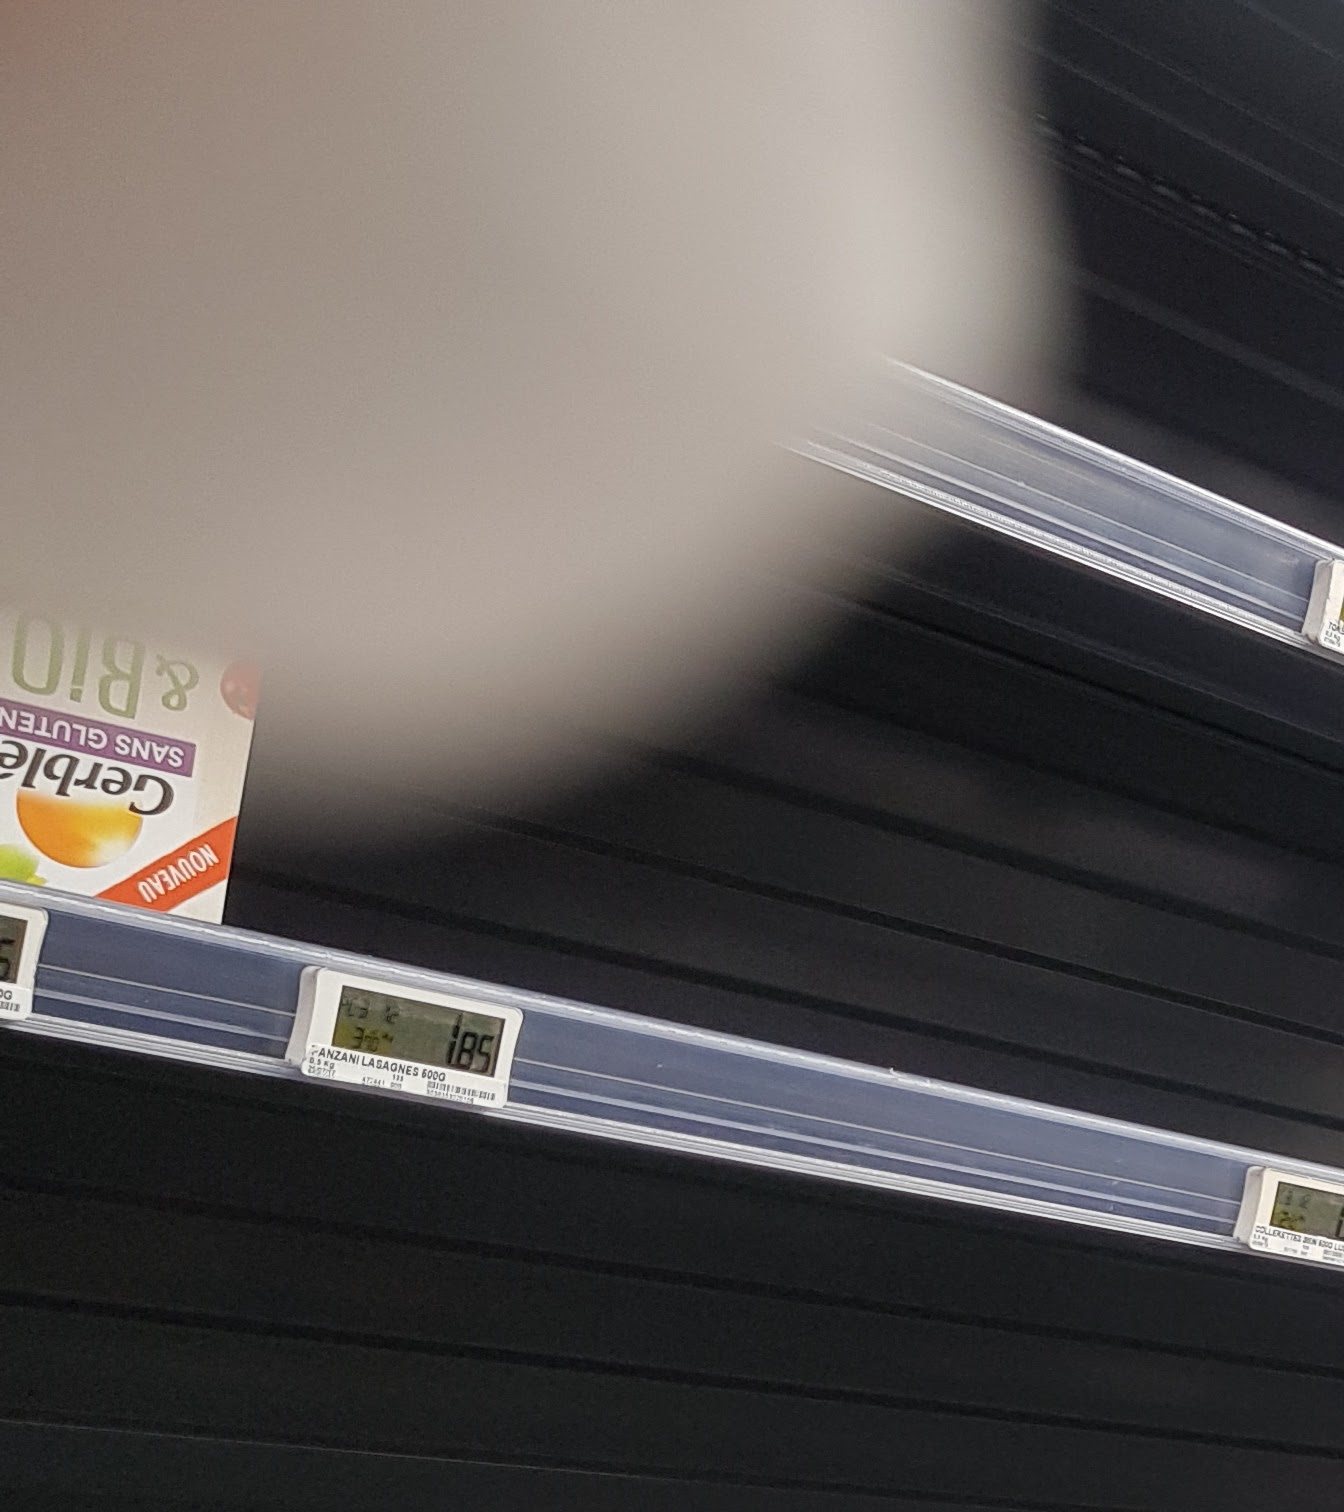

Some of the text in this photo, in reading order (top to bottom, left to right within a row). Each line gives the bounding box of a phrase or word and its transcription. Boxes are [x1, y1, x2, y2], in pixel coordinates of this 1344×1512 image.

[0, 706, 185, 768] SANS GLUTEN
[136, 844, 220, 903] NOUVEAU
[362, 1057, 419, 1076] LASAGNES
